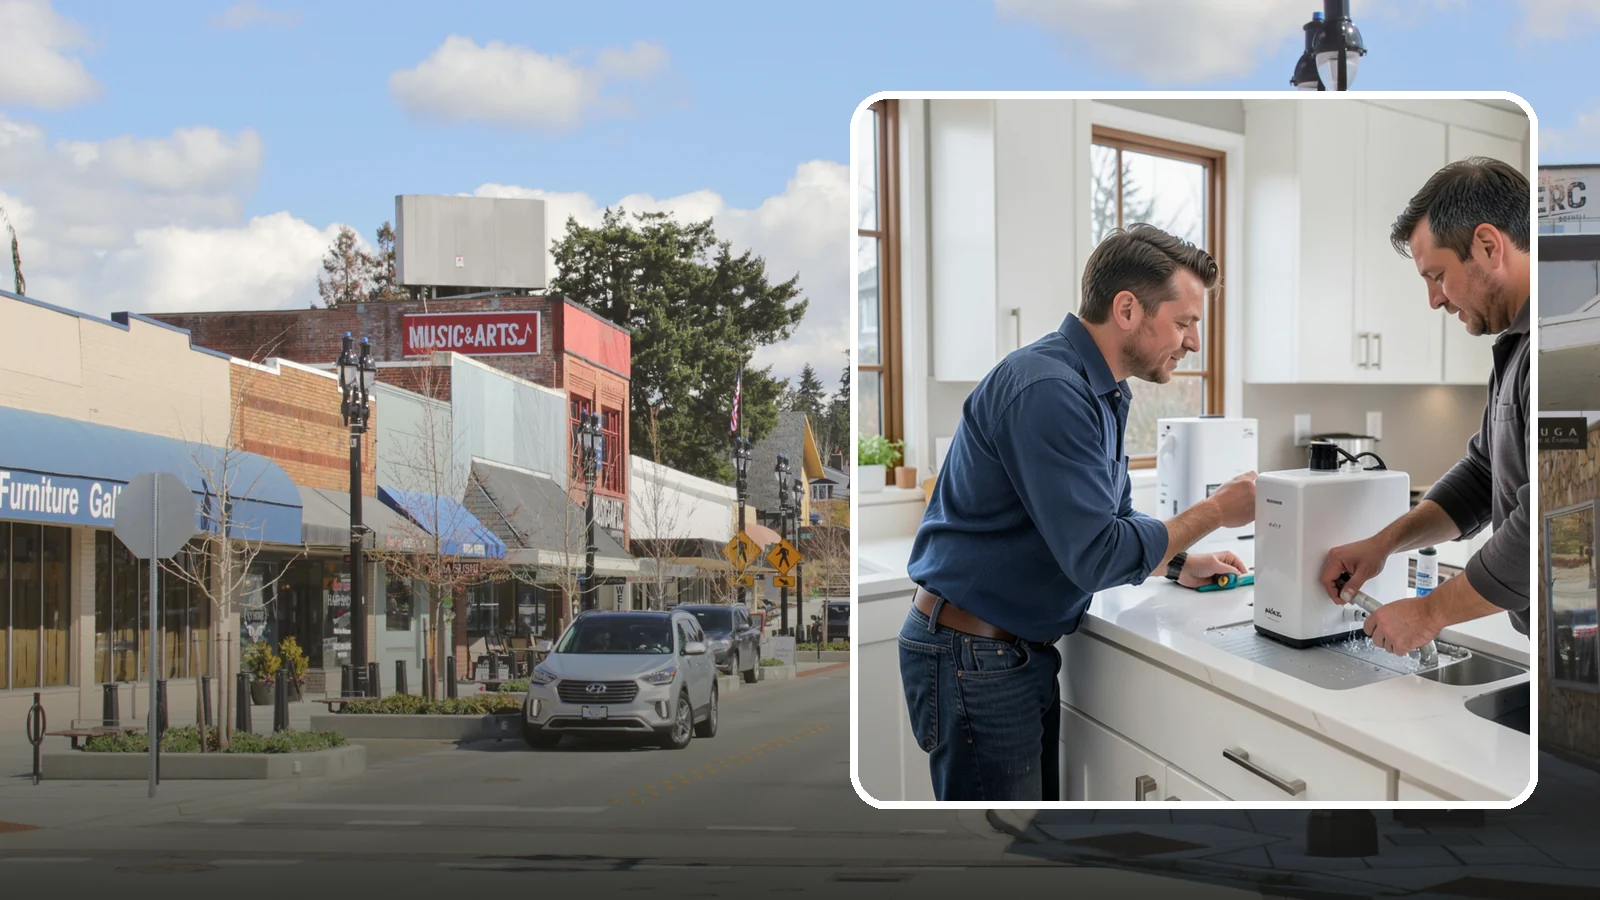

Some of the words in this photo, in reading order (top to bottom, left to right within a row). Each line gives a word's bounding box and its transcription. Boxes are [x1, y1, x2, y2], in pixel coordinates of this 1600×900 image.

[1540, 427, 1577, 437] UGA
[0, 471, 80, 515] Furniture
[453, 563, 480, 574] SUSHI
